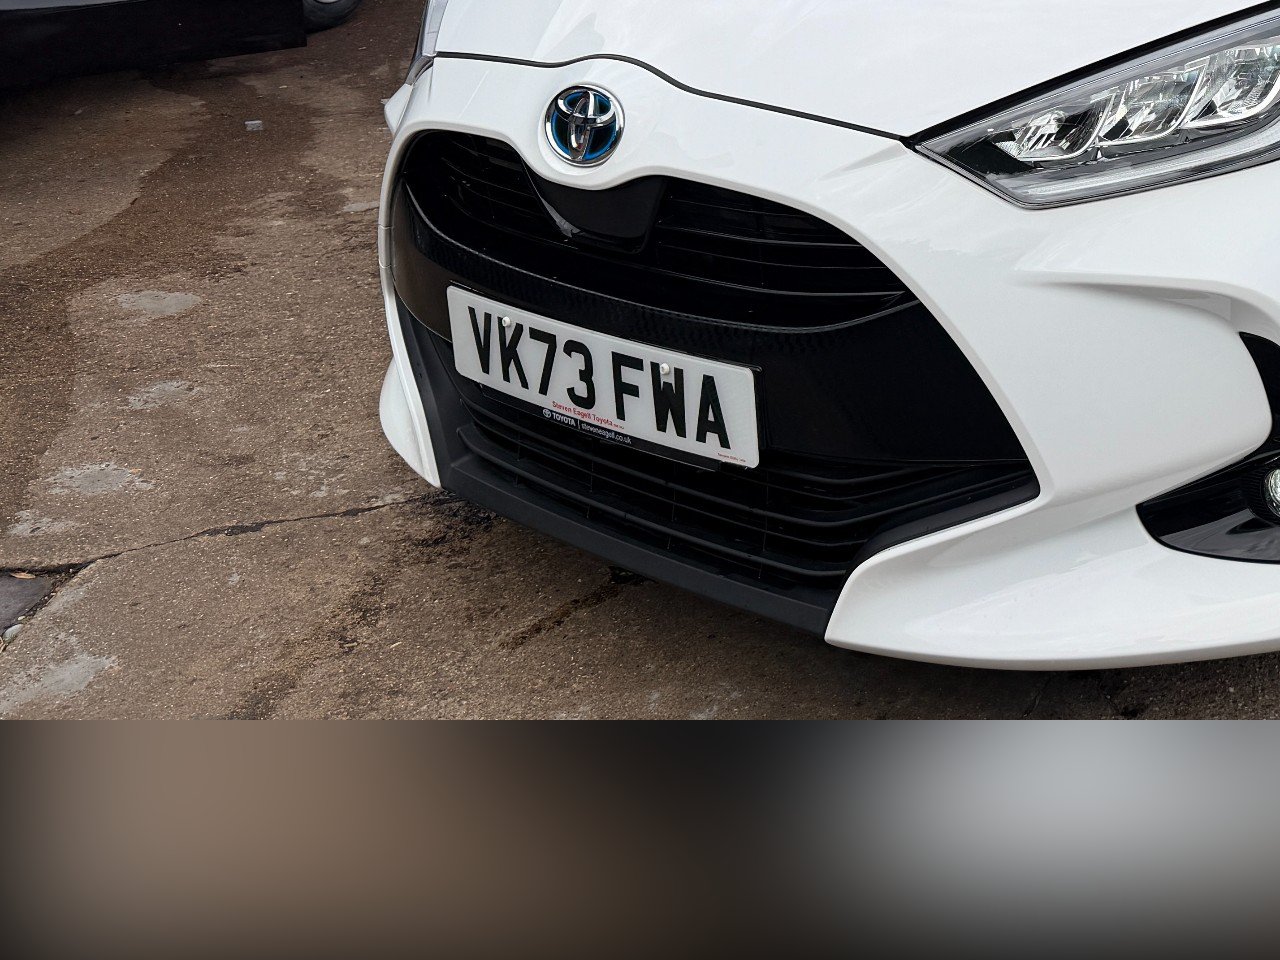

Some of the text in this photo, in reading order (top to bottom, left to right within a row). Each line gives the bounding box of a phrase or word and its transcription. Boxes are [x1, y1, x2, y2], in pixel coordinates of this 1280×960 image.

[467, 305, 731, 450] VK73 FWA
[552, 401, 572, 413] Steven
[592, 413, 613, 426] Toyota
[552, 412, 577, 427] TOYOTA
